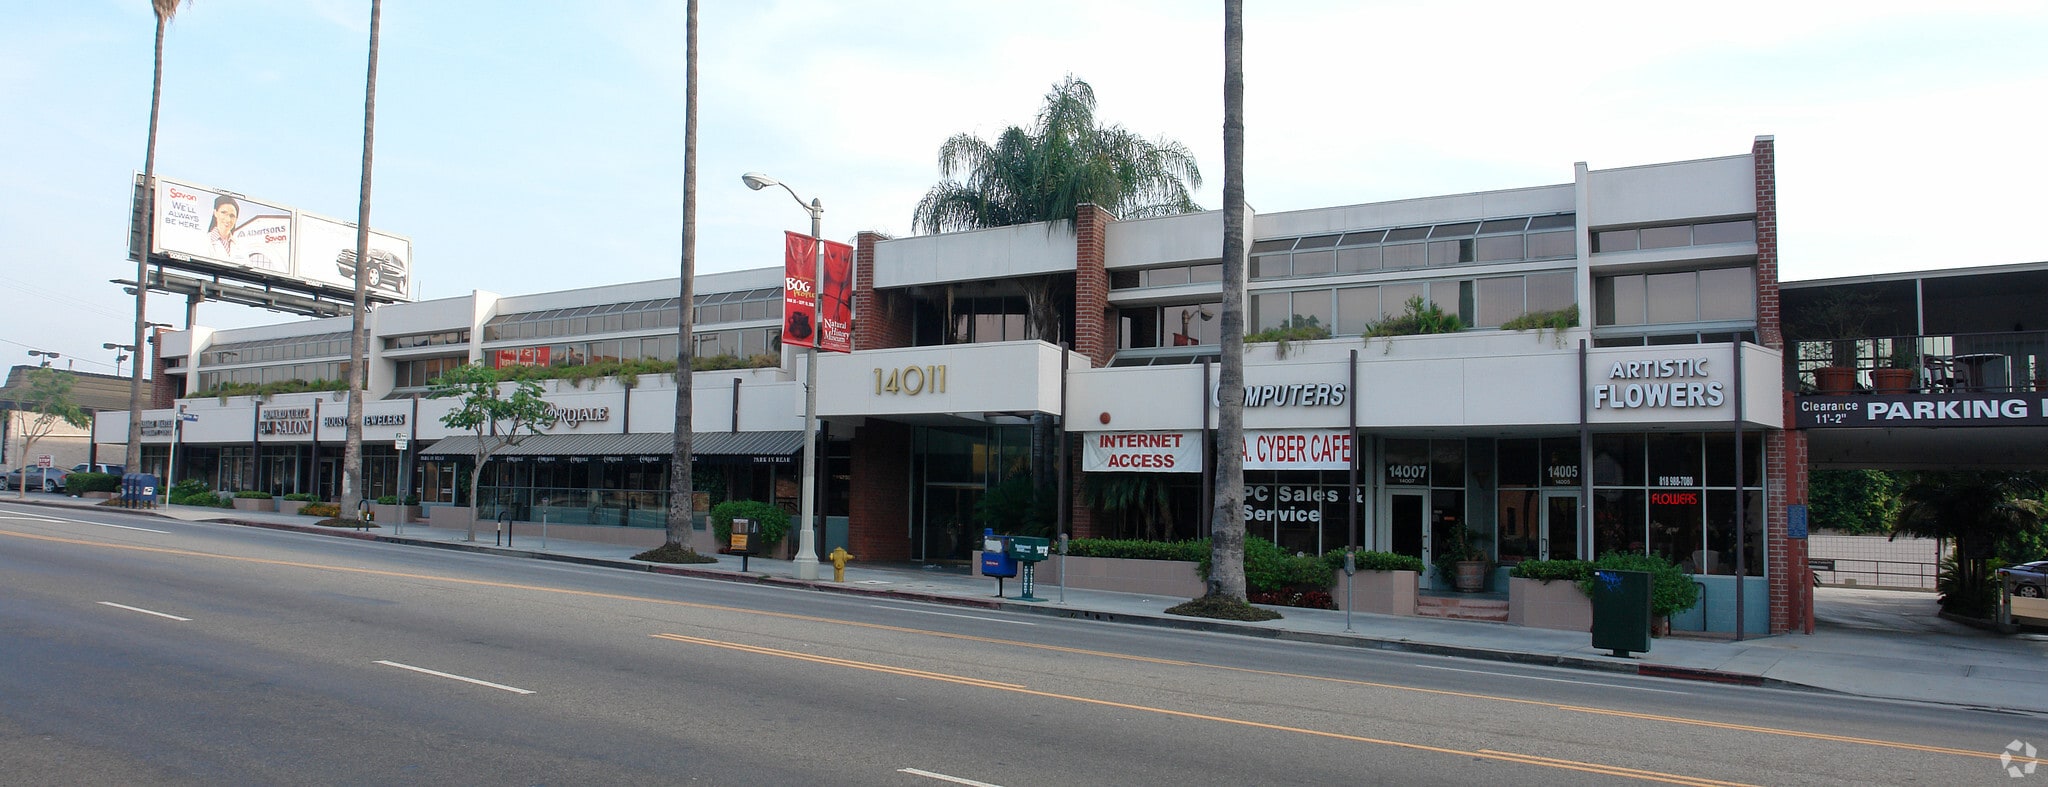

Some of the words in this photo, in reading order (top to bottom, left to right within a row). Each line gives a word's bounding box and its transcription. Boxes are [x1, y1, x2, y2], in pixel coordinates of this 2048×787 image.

[785, 277, 811, 293] BOG
[824, 318, 847, 329] Natural
[824, 330, 845, 342] Museum
[1609, 358, 1708, 379] ARTISTIC
[873, 365, 946, 396] 14011
[1213, 382, 1347, 407] MPUTERS
[1594, 381, 1724, 409] FLOWERS
[1801, 401, 1858, 412] Clearance
[1867, 399, 2028, 420] PARKING
[276, 420, 310, 434] SALON
[1100, 434, 1183, 448] INTERNET
[1257, 434, 1306, 462] CYBER
[1311, 434, 1350, 462] CAFE
[1108, 454, 1175, 468] ACCESS
[1389, 465, 1427, 478] 14007
[1548, 466, 1578, 478] 14005
[1659, 476, 1669, 486] 818
[1244, 486, 1269, 502] PC
[1279, 486, 1339, 502] Sales
[1651, 493, 1698, 505] FLOWERS
[1244, 504, 1321, 522] Service
